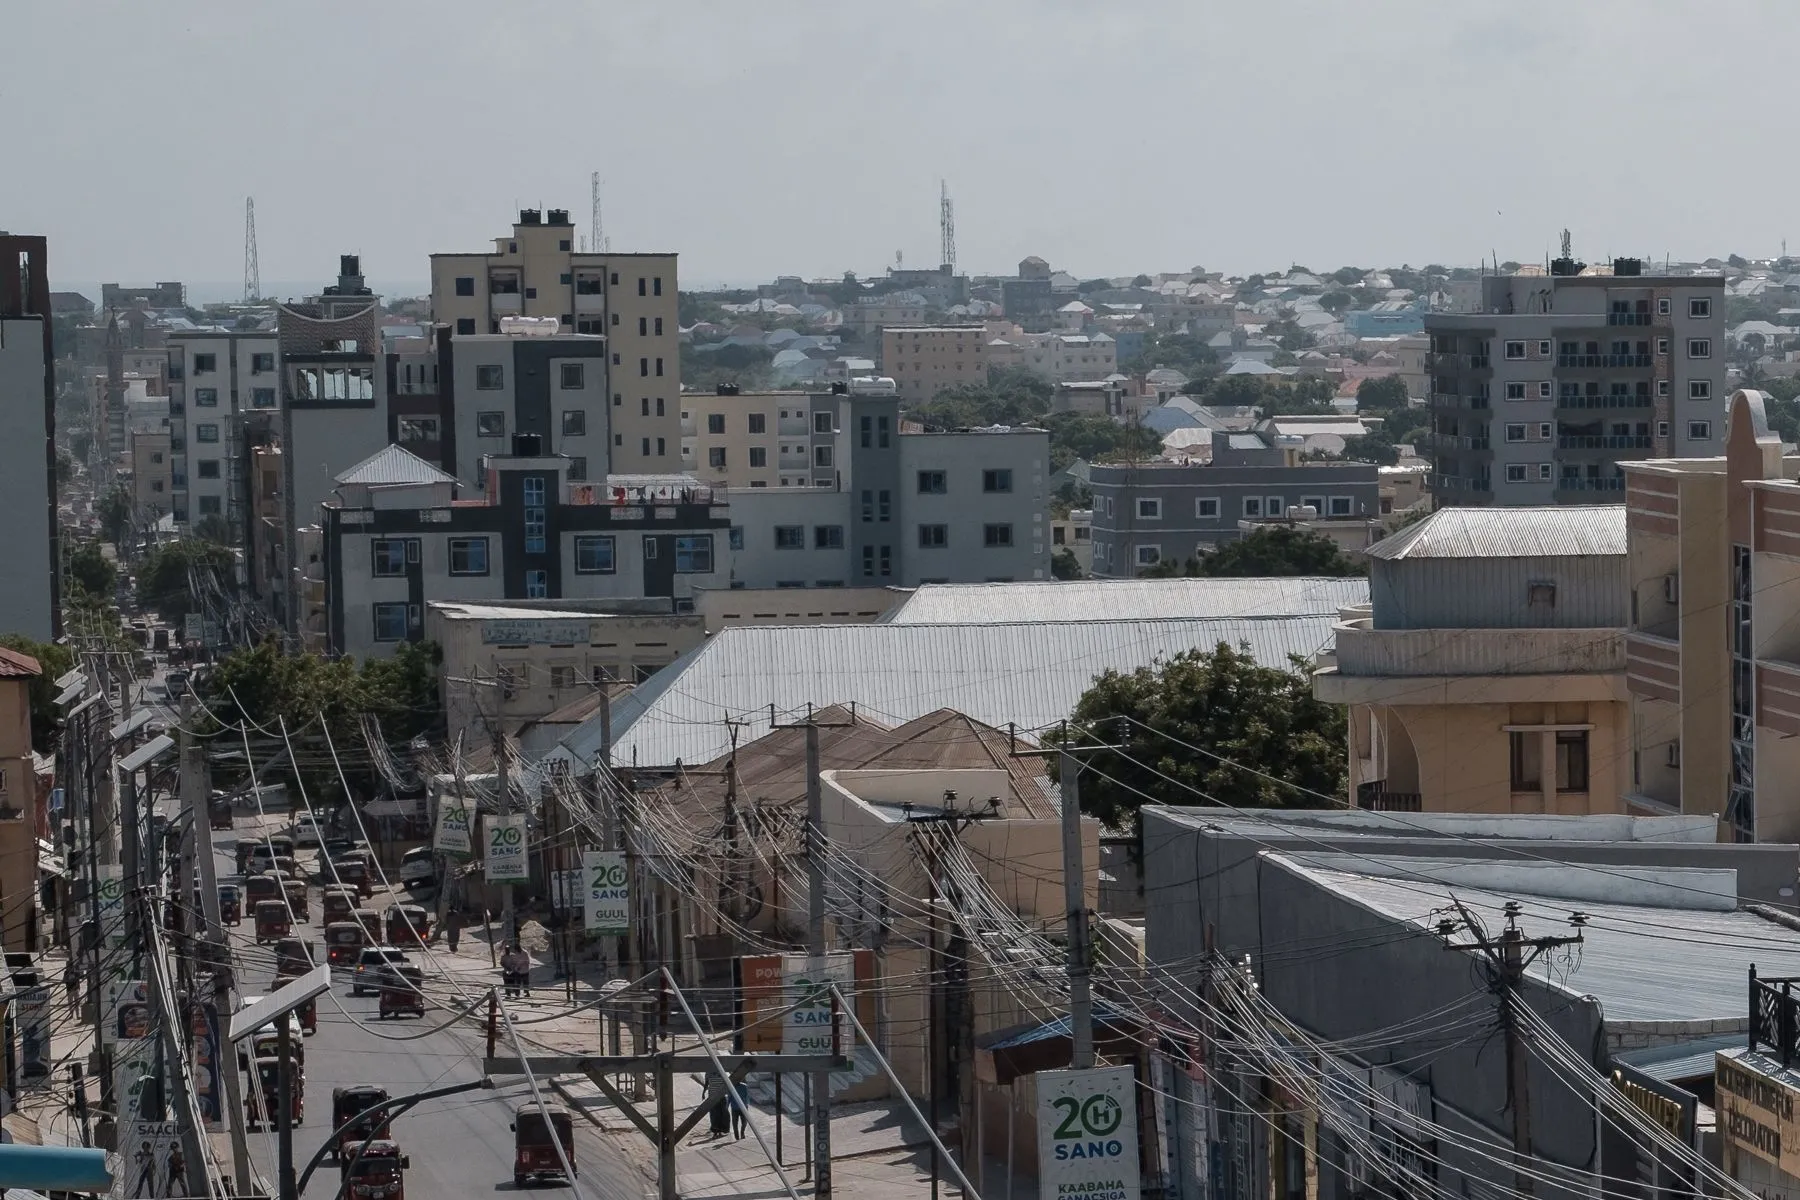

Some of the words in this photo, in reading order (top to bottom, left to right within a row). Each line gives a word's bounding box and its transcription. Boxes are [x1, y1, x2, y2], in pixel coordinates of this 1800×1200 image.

[490, 827, 522, 846] 20
[491, 847, 522, 856] SANO
[591, 864, 628, 889] 20
[592, 889, 629, 900] SANO
[595, 909, 627, 919] GUUL
[1052, 1094, 1123, 1140] 20
[1054, 1139, 1123, 1161] SANO
[1058, 1179, 1125, 1194] KAABAHA
